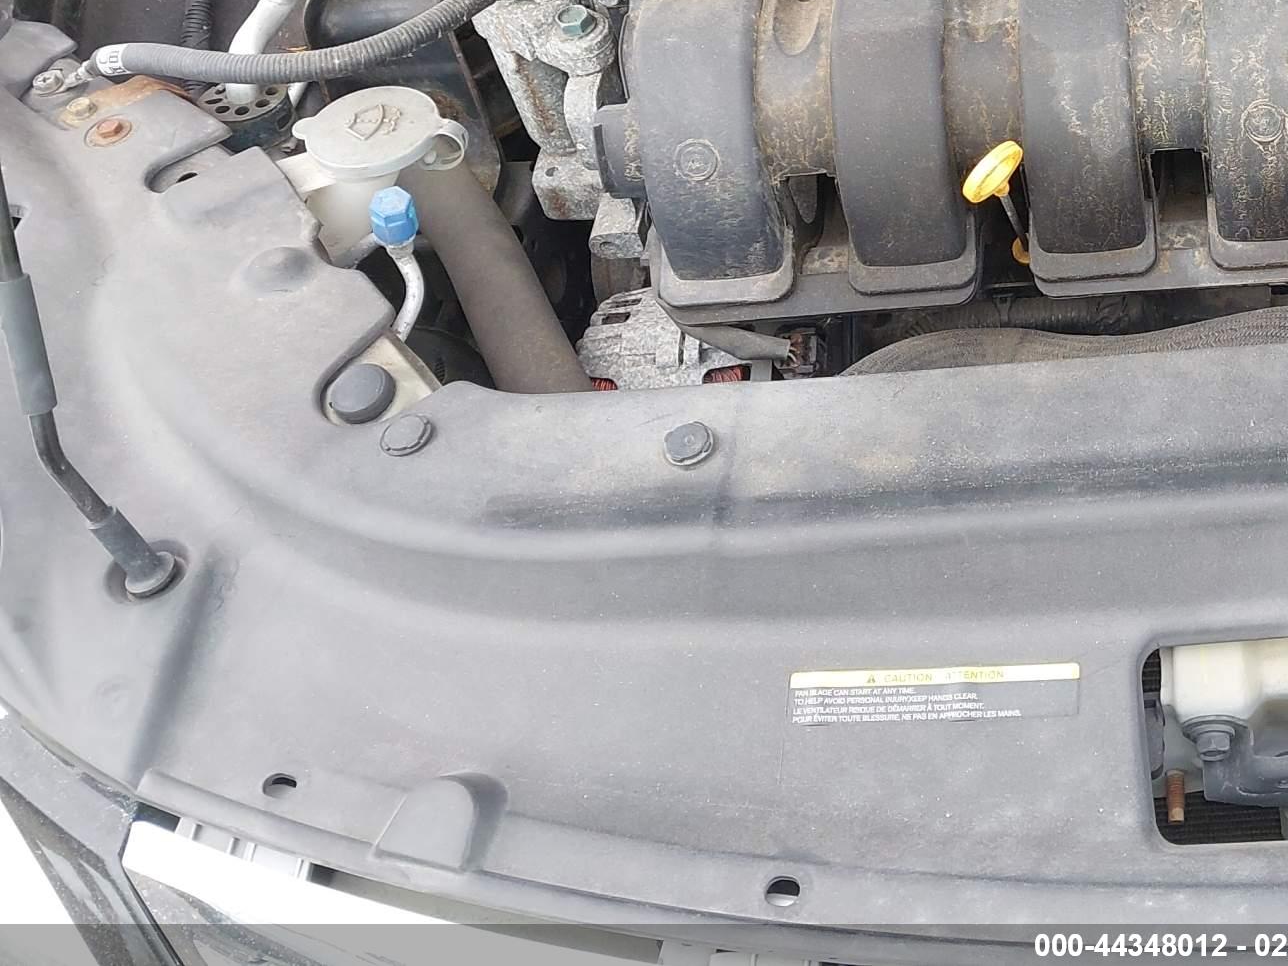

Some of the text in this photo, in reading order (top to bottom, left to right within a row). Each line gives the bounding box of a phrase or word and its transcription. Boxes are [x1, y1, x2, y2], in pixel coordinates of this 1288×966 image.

[884, 673, 933, 683] CAUTION
[795, 689, 809, 697] FAN
[810, 688, 832, 697] BLADE
[833, 688, 849, 696] CAN
[851, 687, 872, 696] START
[872, 687, 883, 695] AT
[883, 686, 898, 695] ANY
[794, 698, 805, 706] TO
[805, 698, 824, 706] HELP
[823, 697, 846, 705] AVOID
[847, 696, 885, 705] PERSONAL
[928, 694, 953, 702] HANDS
[793, 707, 804, 715] LE
[803, 706, 848, 715] VENTILATEUR
[848, 706, 875, 714] RISQUE
[876, 705, 886, 713] DE
[934, 703, 953, 711] TOUT
[792, 715, 814, 724] POUR
[838, 714, 862, 723] TOUTE
[902, 713, 913, 722] NE
[913, 713, 927, 721] PAS
[928, 712, 938, 720] EN
[938, 711, 983, 720] APPROCHER
[983, 710, 998, 718] LES
